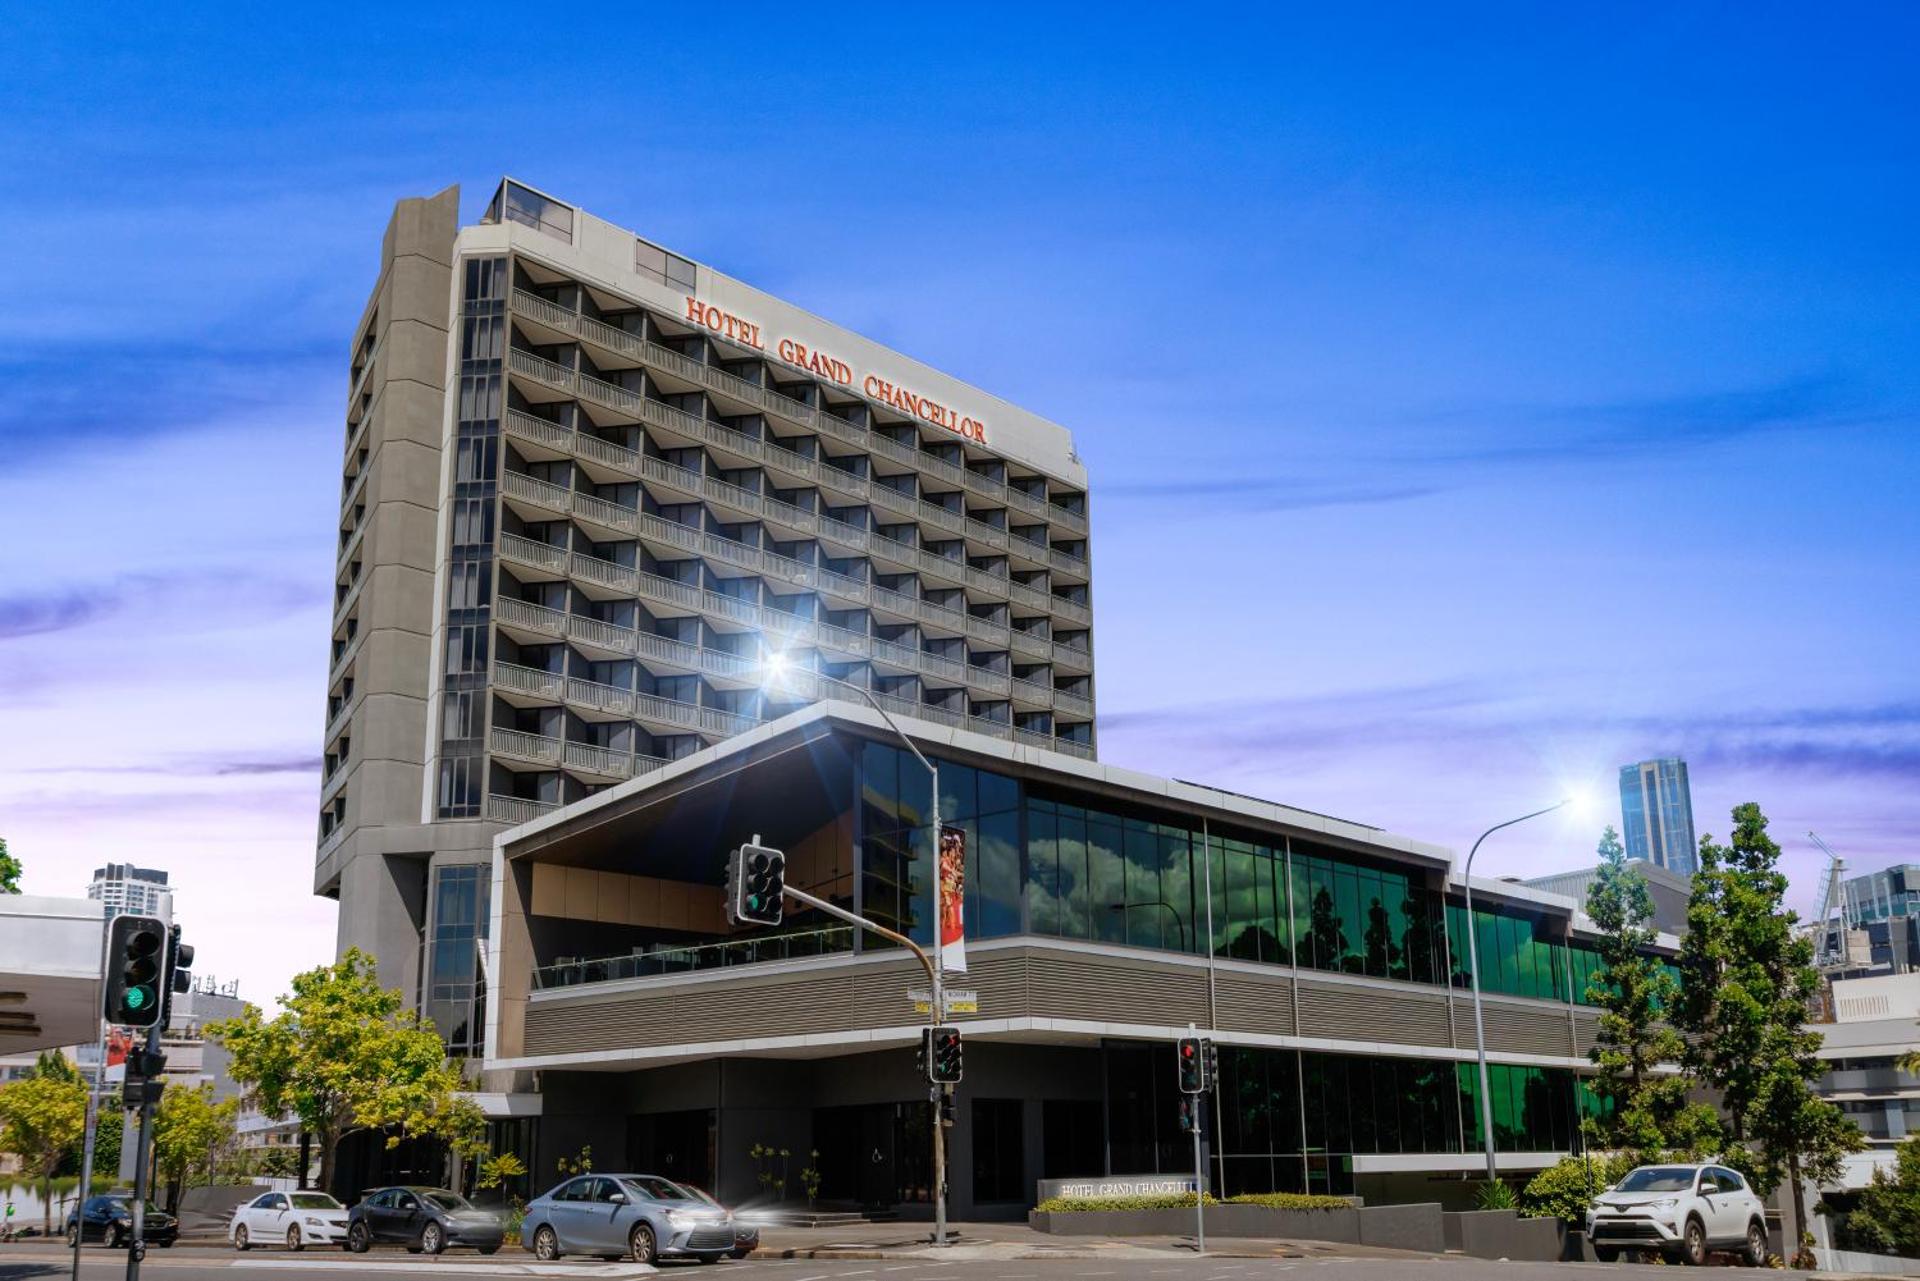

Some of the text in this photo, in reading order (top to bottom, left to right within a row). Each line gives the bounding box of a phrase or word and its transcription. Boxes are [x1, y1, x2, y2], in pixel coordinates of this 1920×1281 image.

[686, 296, 987, 444] HOTEL GRAND CHANCELLOR
[1062, 1184, 1094, 1197] HOTEL
[1100, 1183, 1132, 1196] GRAND
